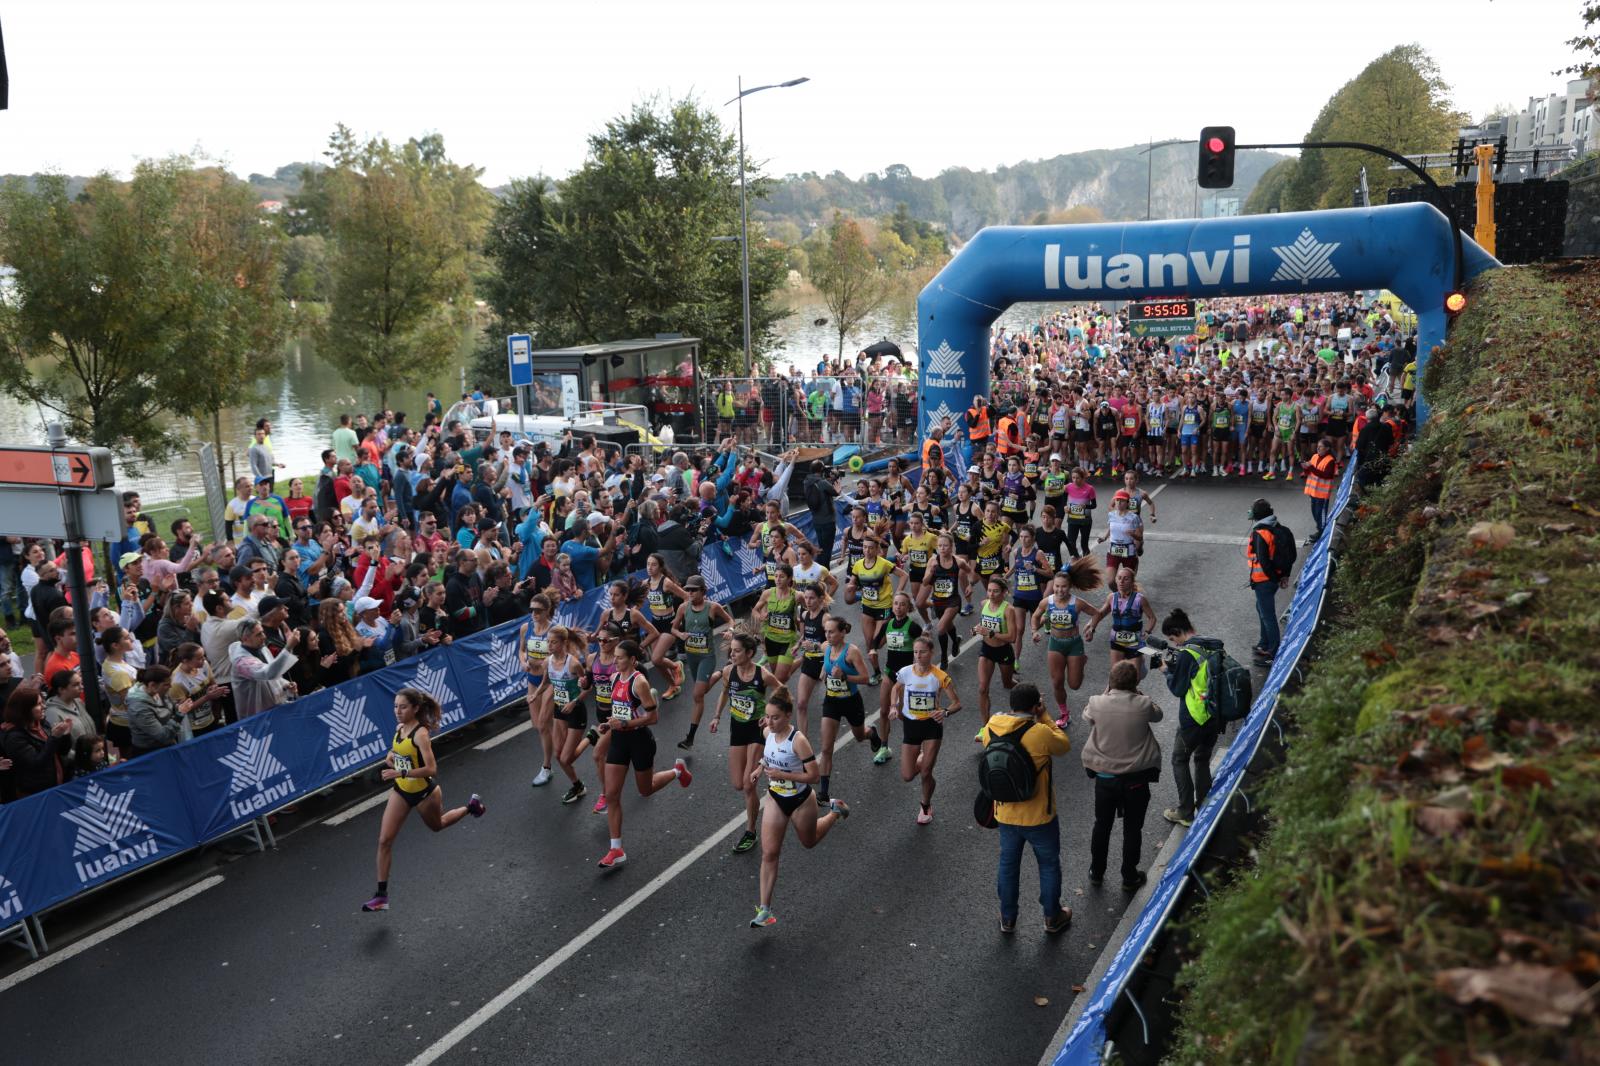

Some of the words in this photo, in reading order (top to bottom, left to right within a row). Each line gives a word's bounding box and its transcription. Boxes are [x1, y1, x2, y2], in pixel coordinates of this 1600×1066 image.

[1044, 234, 1251, 290] luanvi
[1143, 303, 1188, 317] 9:55:05
[926, 375, 967, 388] luanvi
[983, 620, 997, 629] 337
[892, 636, 897, 644] 3
[1117, 632, 1133, 640] 247
[535, 641, 541, 649] 5
[915, 697, 928, 706] 21
[613, 705, 629, 715] 322
[329, 734, 387, 773] luanvi
[230, 774, 296, 820] luanvi
[74, 834, 159, 883] luanvi
